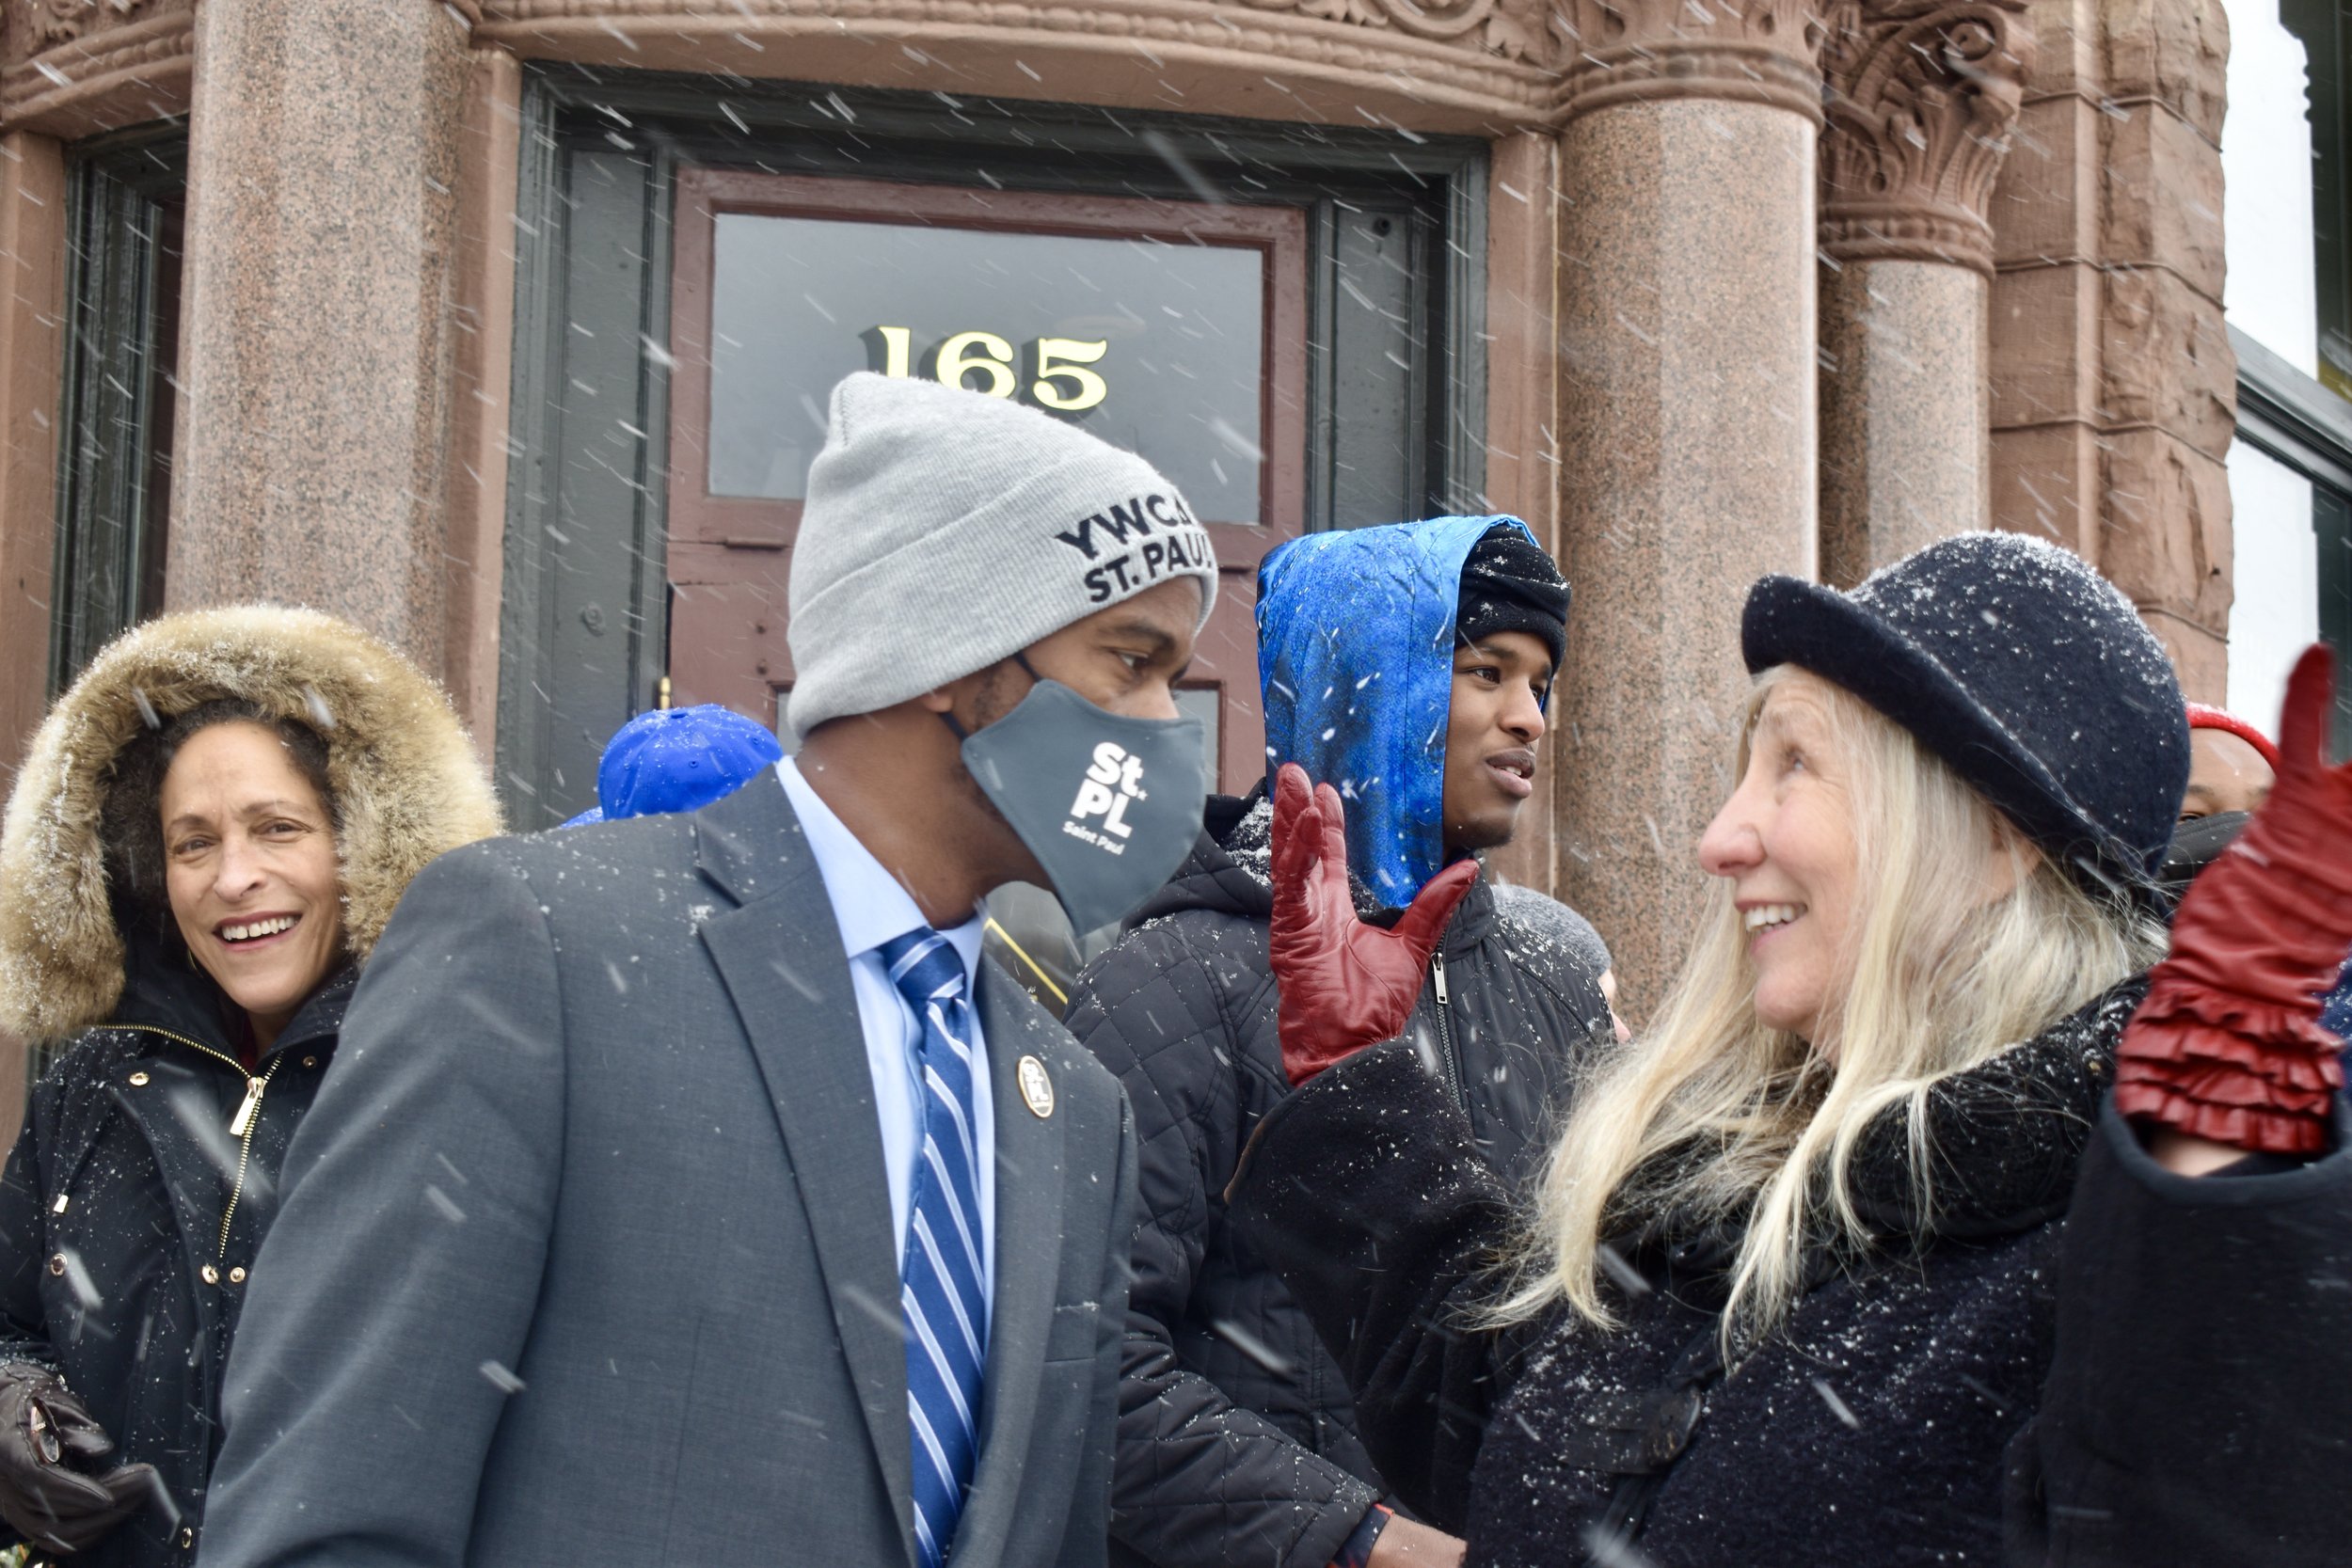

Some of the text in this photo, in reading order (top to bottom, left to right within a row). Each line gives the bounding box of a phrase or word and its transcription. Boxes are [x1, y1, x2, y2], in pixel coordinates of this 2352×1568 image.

[876, 325, 1107, 411] 165
[1055, 494, 1193, 561] YWCA
[1084, 555, 1140, 602] ST.
[1062, 820, 1125, 855] Saint Paul
[1070, 778, 1133, 838] PL
